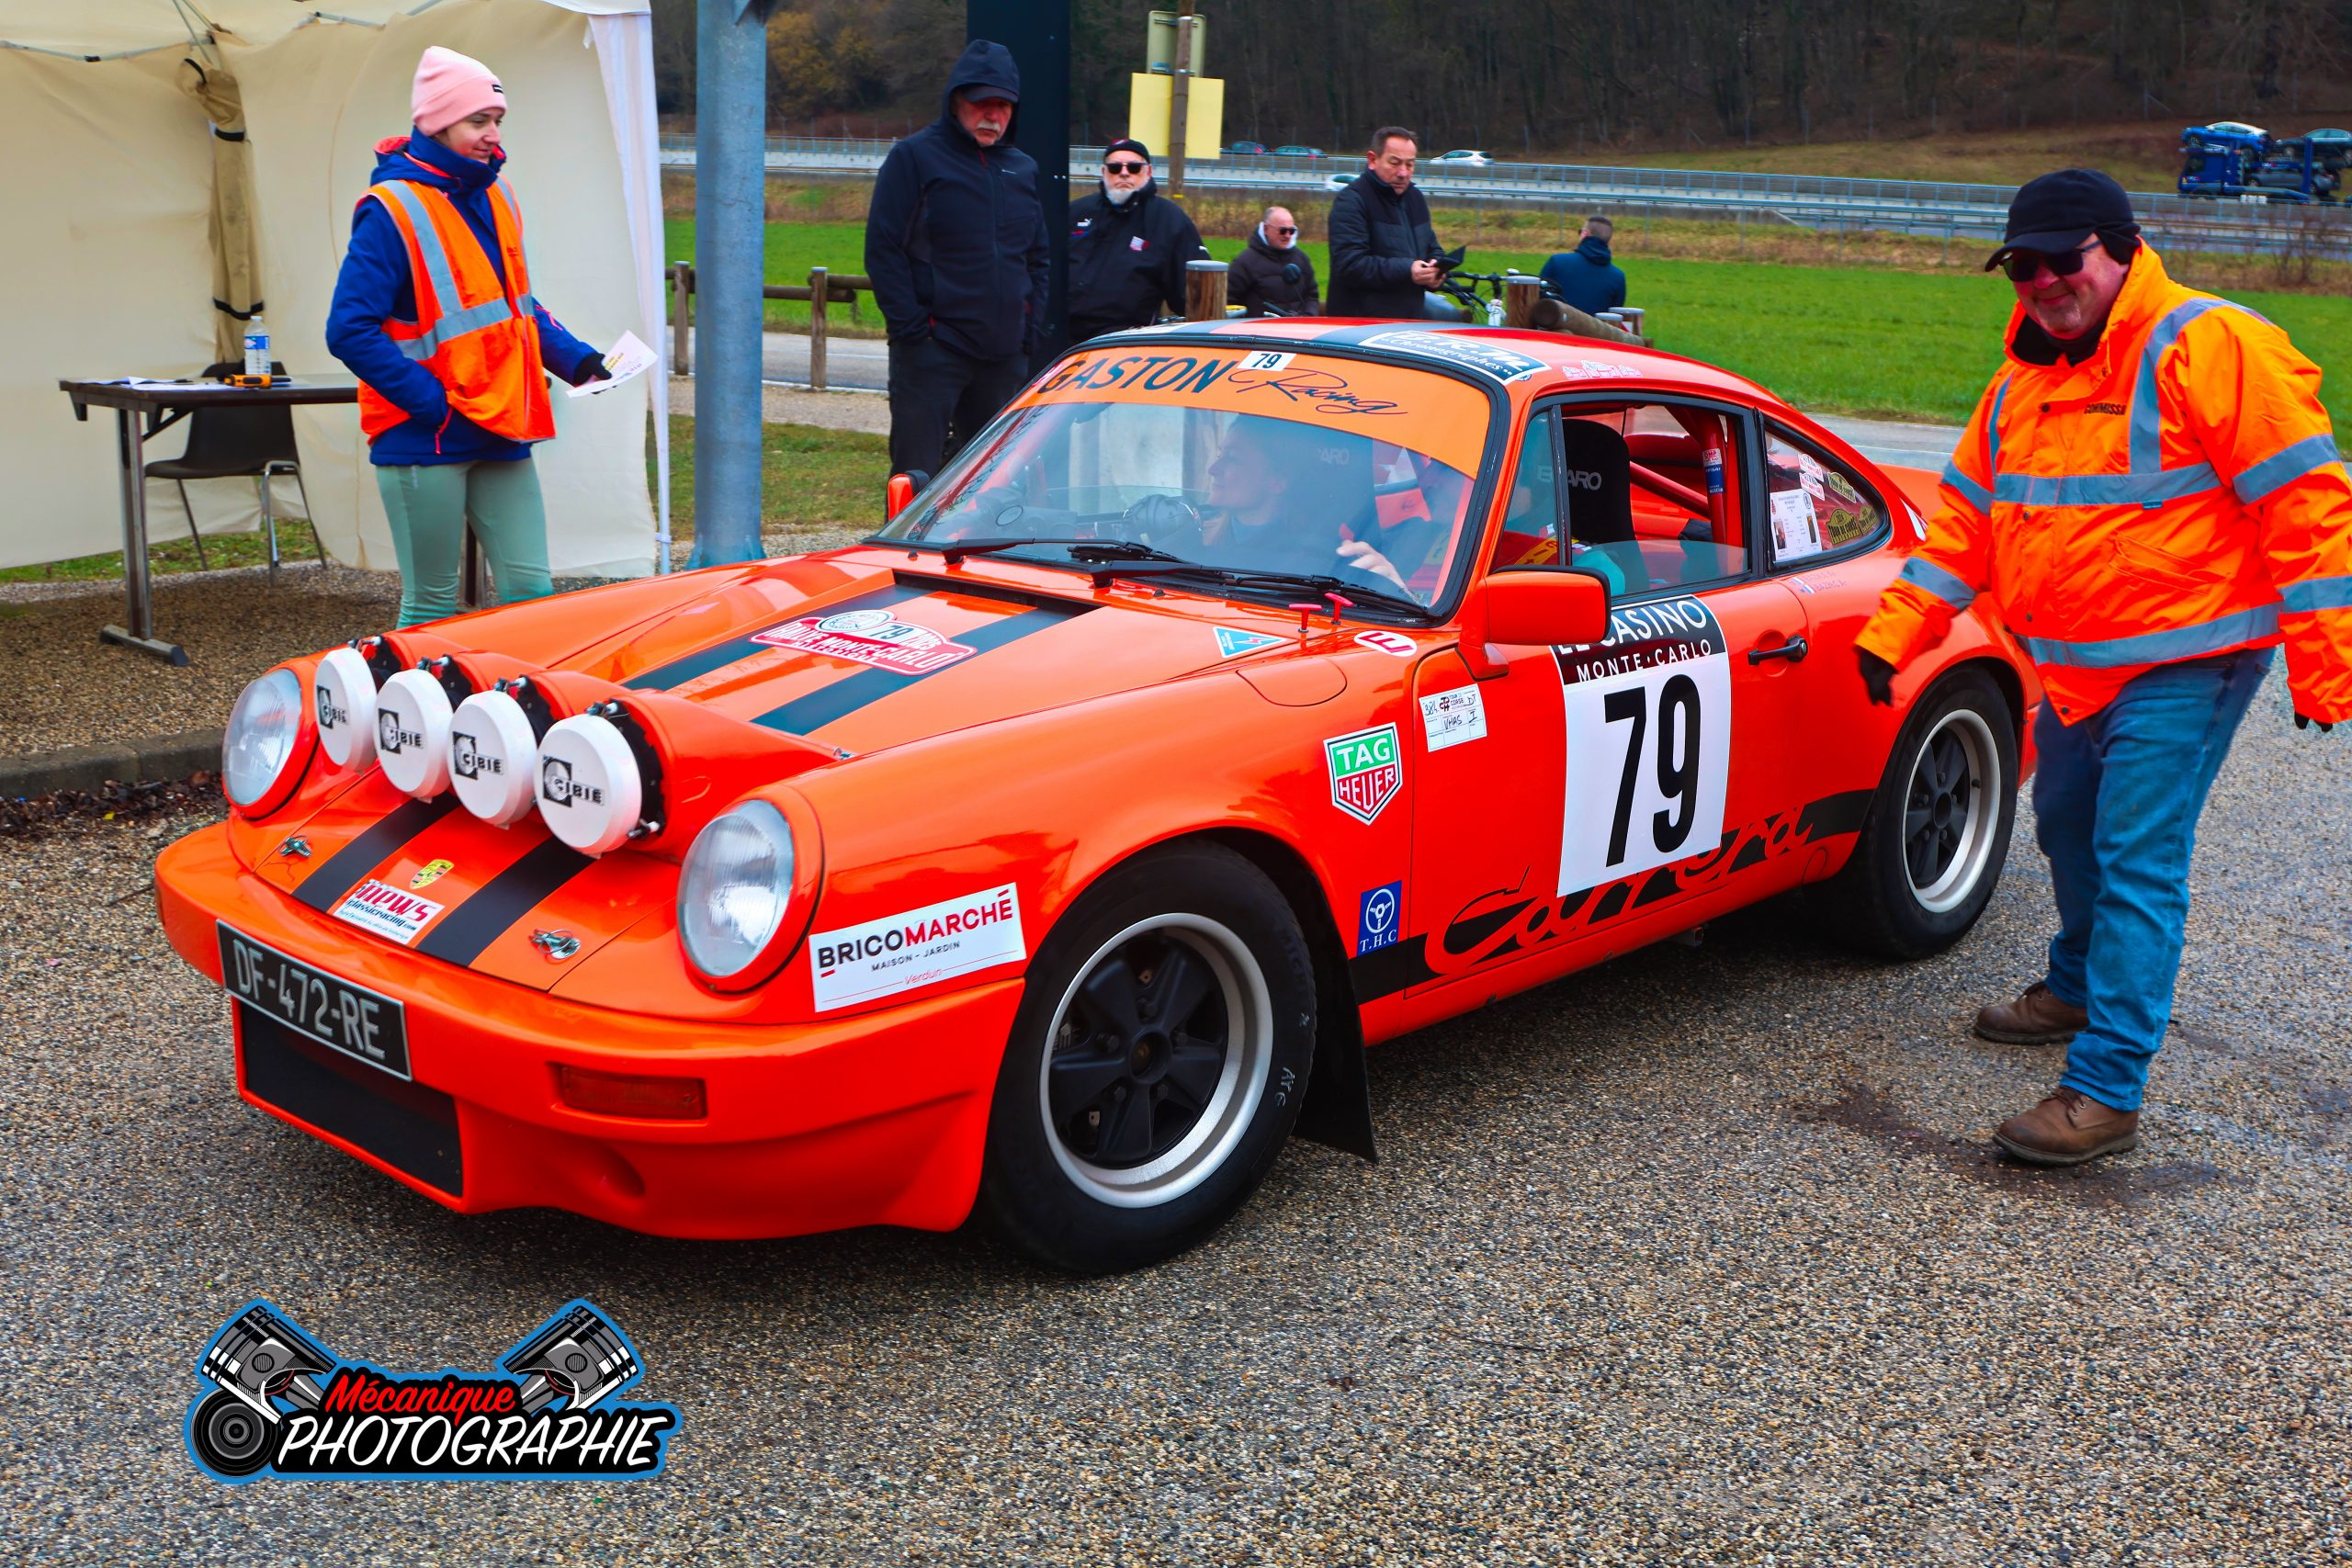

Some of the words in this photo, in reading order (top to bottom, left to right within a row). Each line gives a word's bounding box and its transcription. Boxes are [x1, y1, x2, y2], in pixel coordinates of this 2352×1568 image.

[1251, 353, 1283, 368] 79
[1037, 356, 1238, 394] GASTON
[1228, 367, 1408, 414] Racing
[870, 625, 914, 639] 79
[1357, 632, 1415, 653] E
[1336, 738, 1390, 771] TAG
[1603, 673, 1702, 868] 79
[1339, 767, 1395, 810] HEUER
[356, 885, 437, 922] news
[818, 888, 1013, 970] BRICOMARCHÉ
[1360, 930, 1396, 953] T.H.C
[871, 953, 912, 972] MAISON
[922, 941, 961, 959] JARDIN
[904, 967, 943, 986] Verdun
[233, 939, 386, 1060] DF-472-RE
